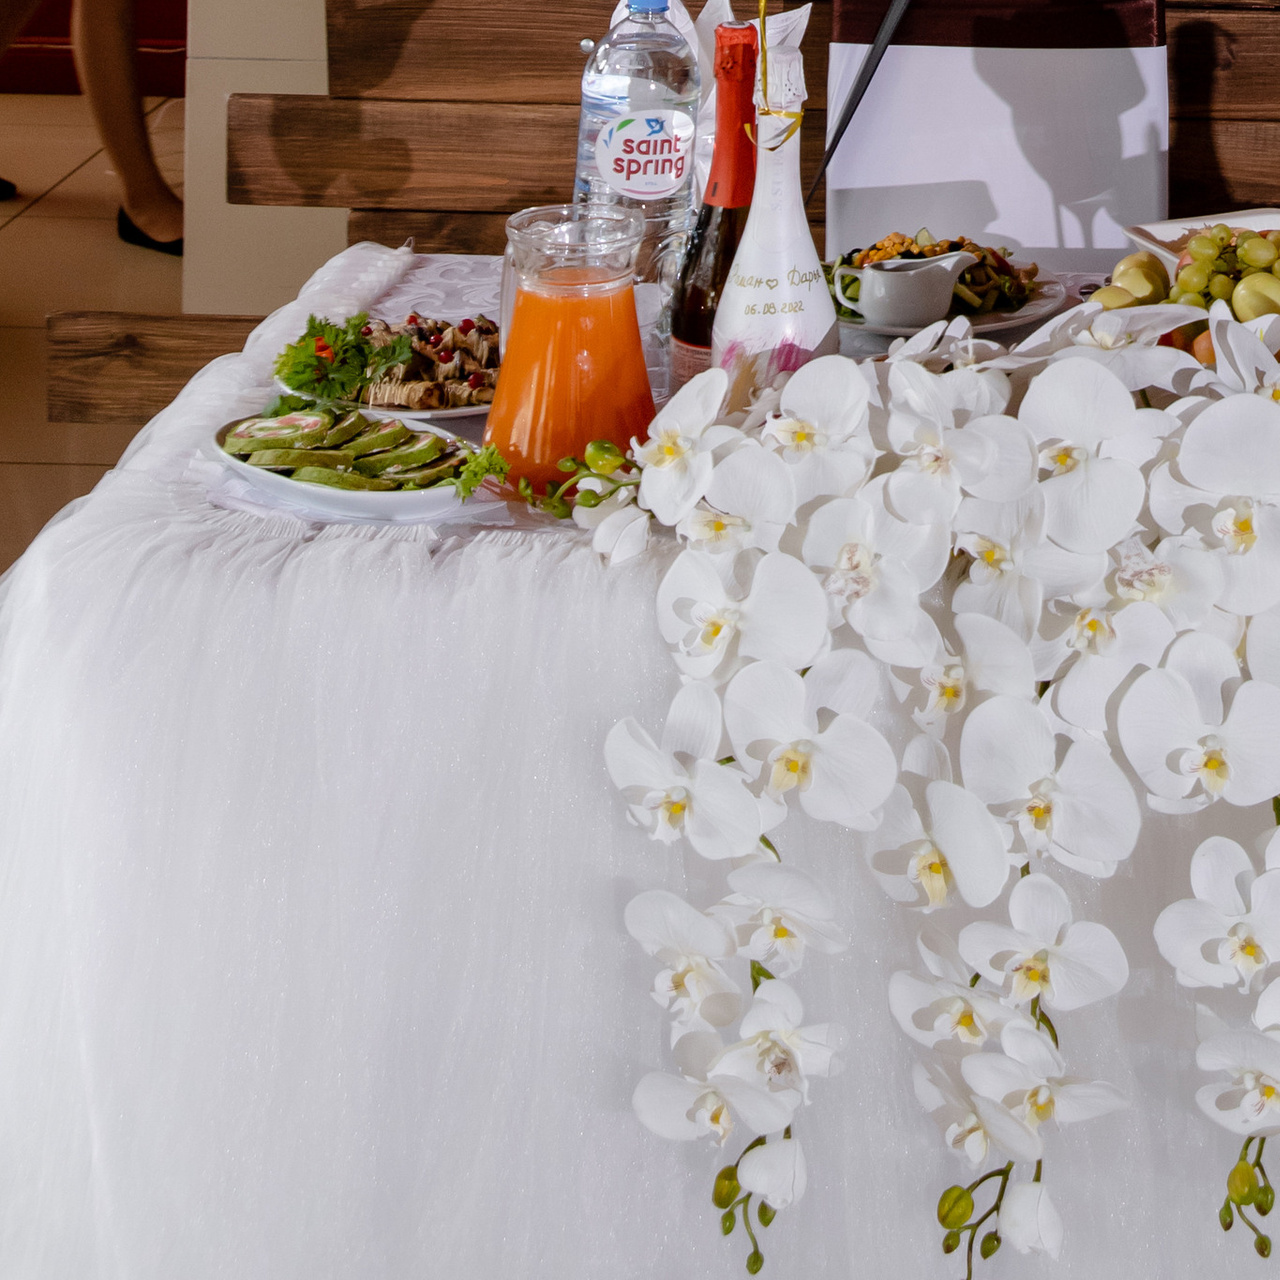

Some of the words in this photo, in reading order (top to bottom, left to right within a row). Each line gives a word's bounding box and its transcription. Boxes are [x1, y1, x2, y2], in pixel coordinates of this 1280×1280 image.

[622, 134, 681, 155] saint
[612, 157, 685, 181] spring
[744, 300, 804, 315] 06.08.2022
